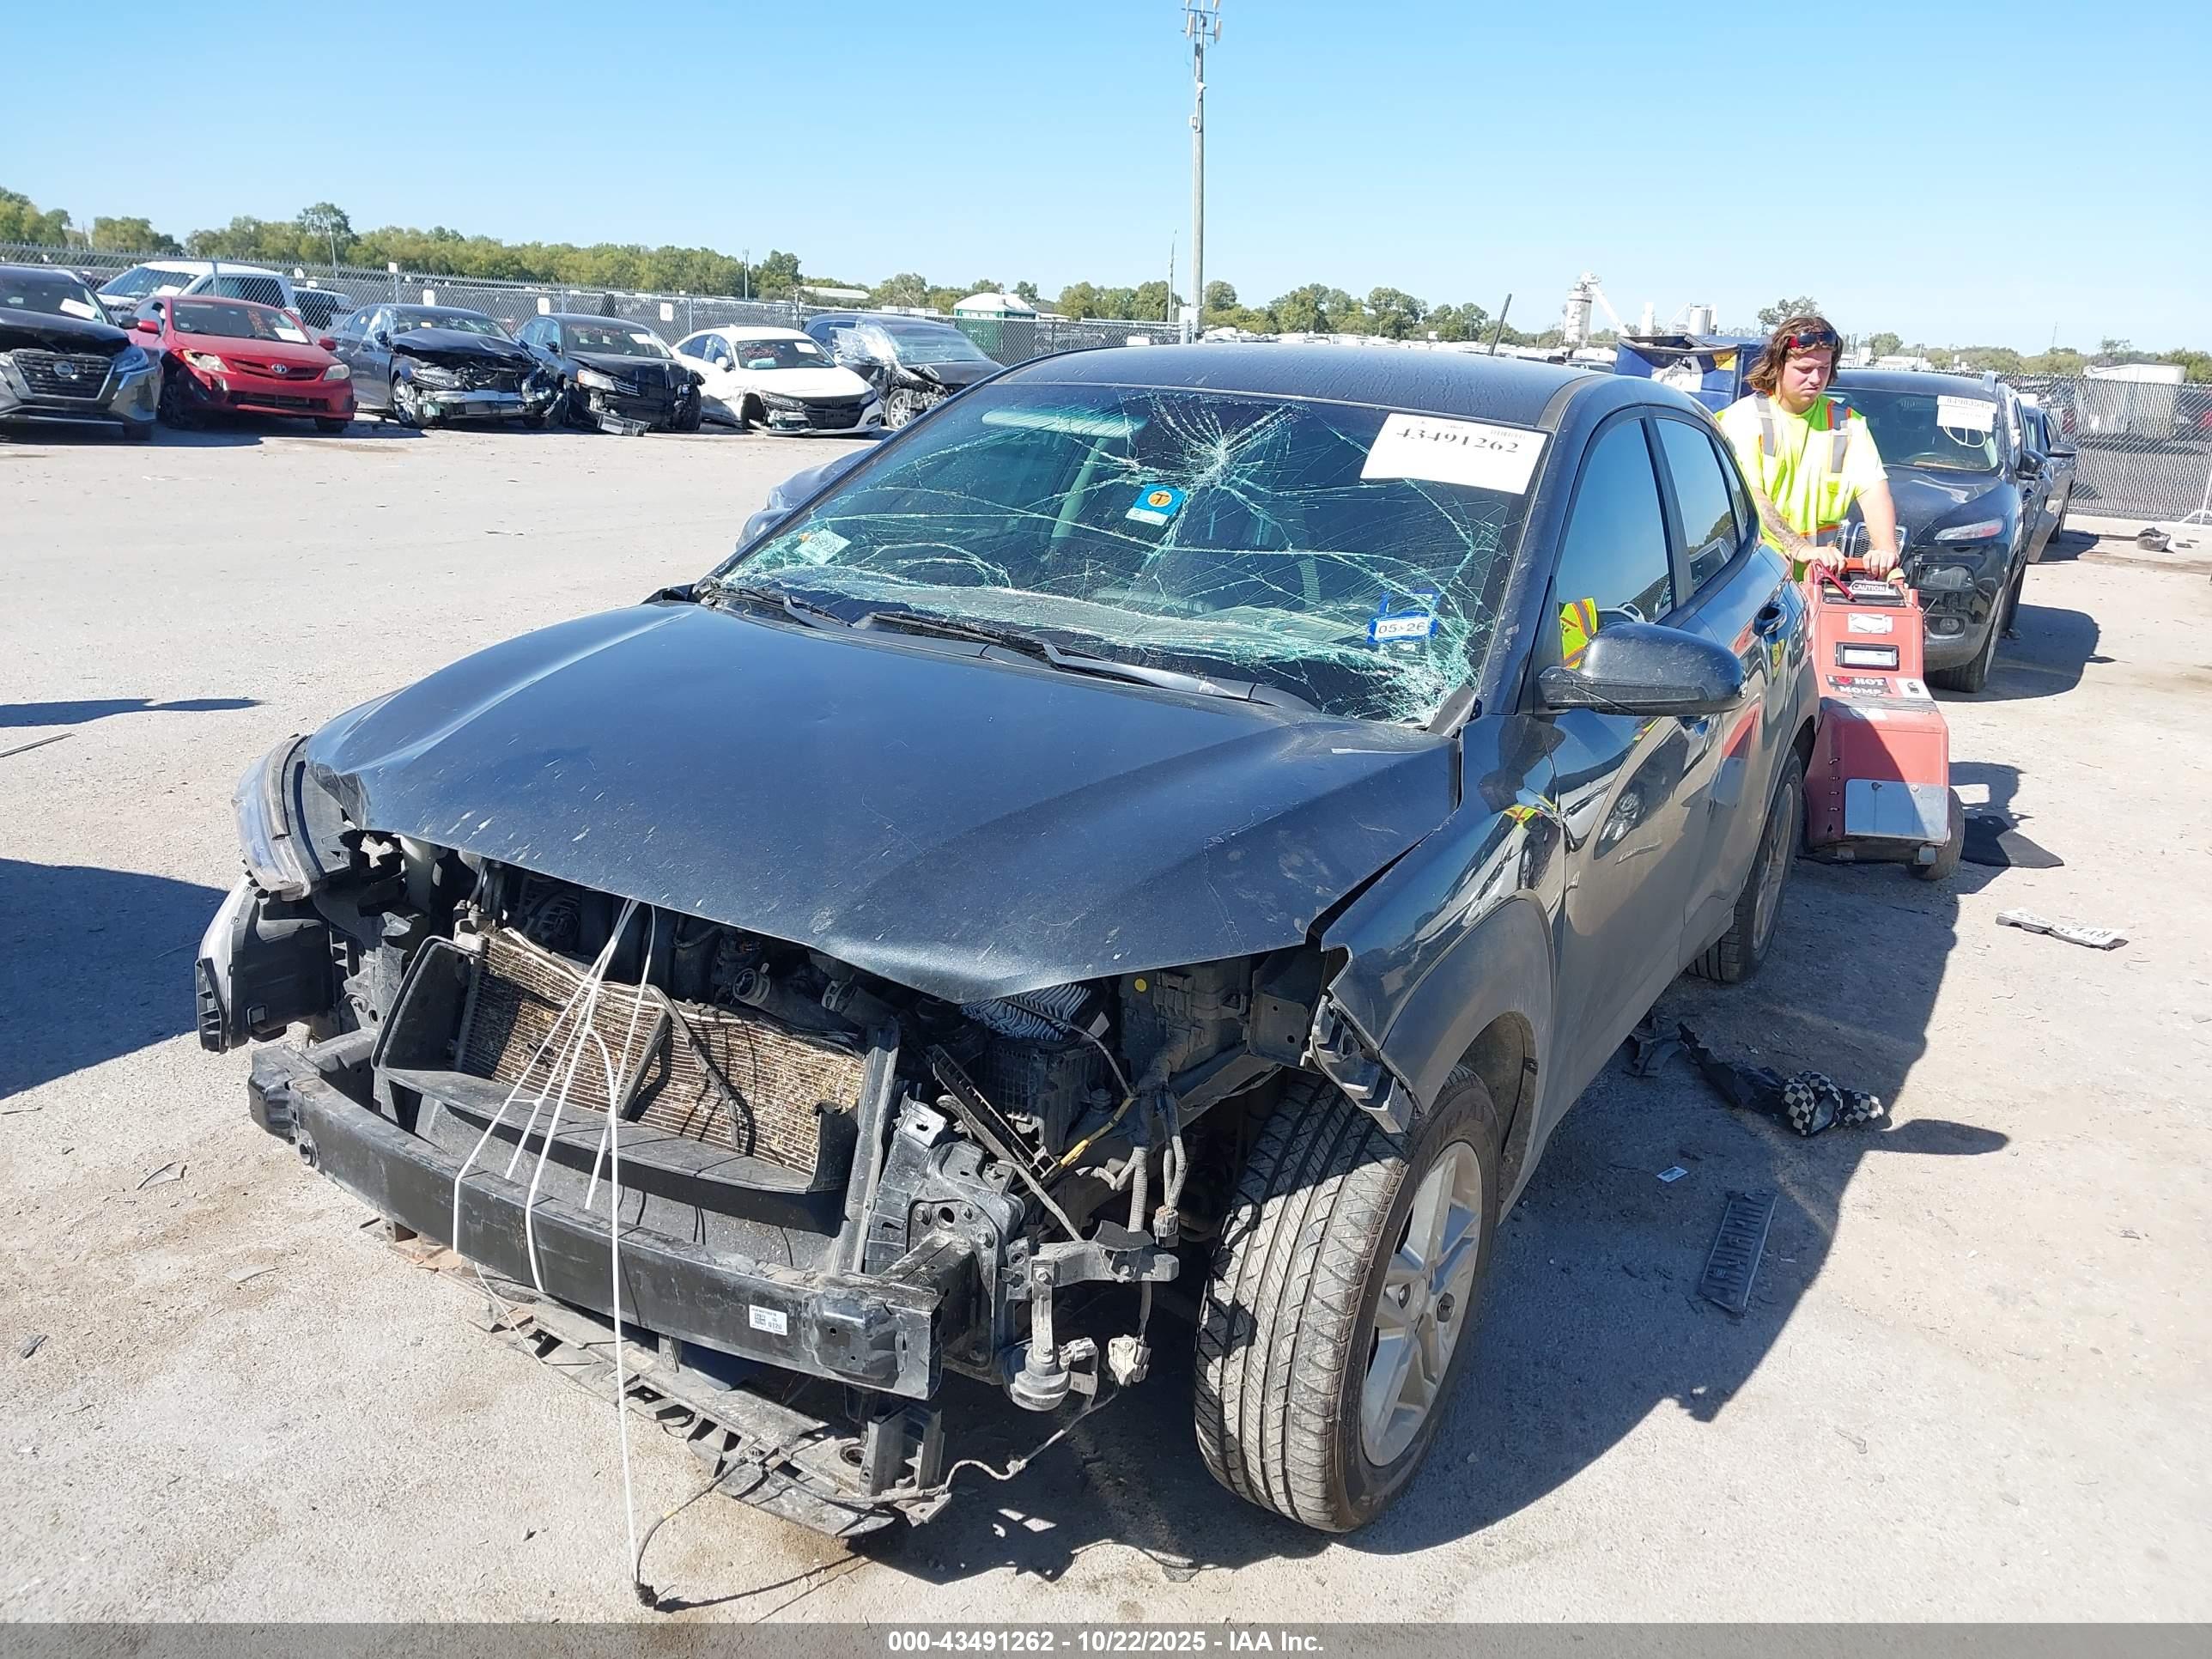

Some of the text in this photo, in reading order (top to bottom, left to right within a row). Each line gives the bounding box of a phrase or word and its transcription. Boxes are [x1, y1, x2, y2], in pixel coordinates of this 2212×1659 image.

[1396, 428, 1520, 453] 43491262
[1852, 583, 1886, 592] CAUTION
[1854, 677, 1885, 686] HOT
[1838, 685, 1882, 695] MOMS
